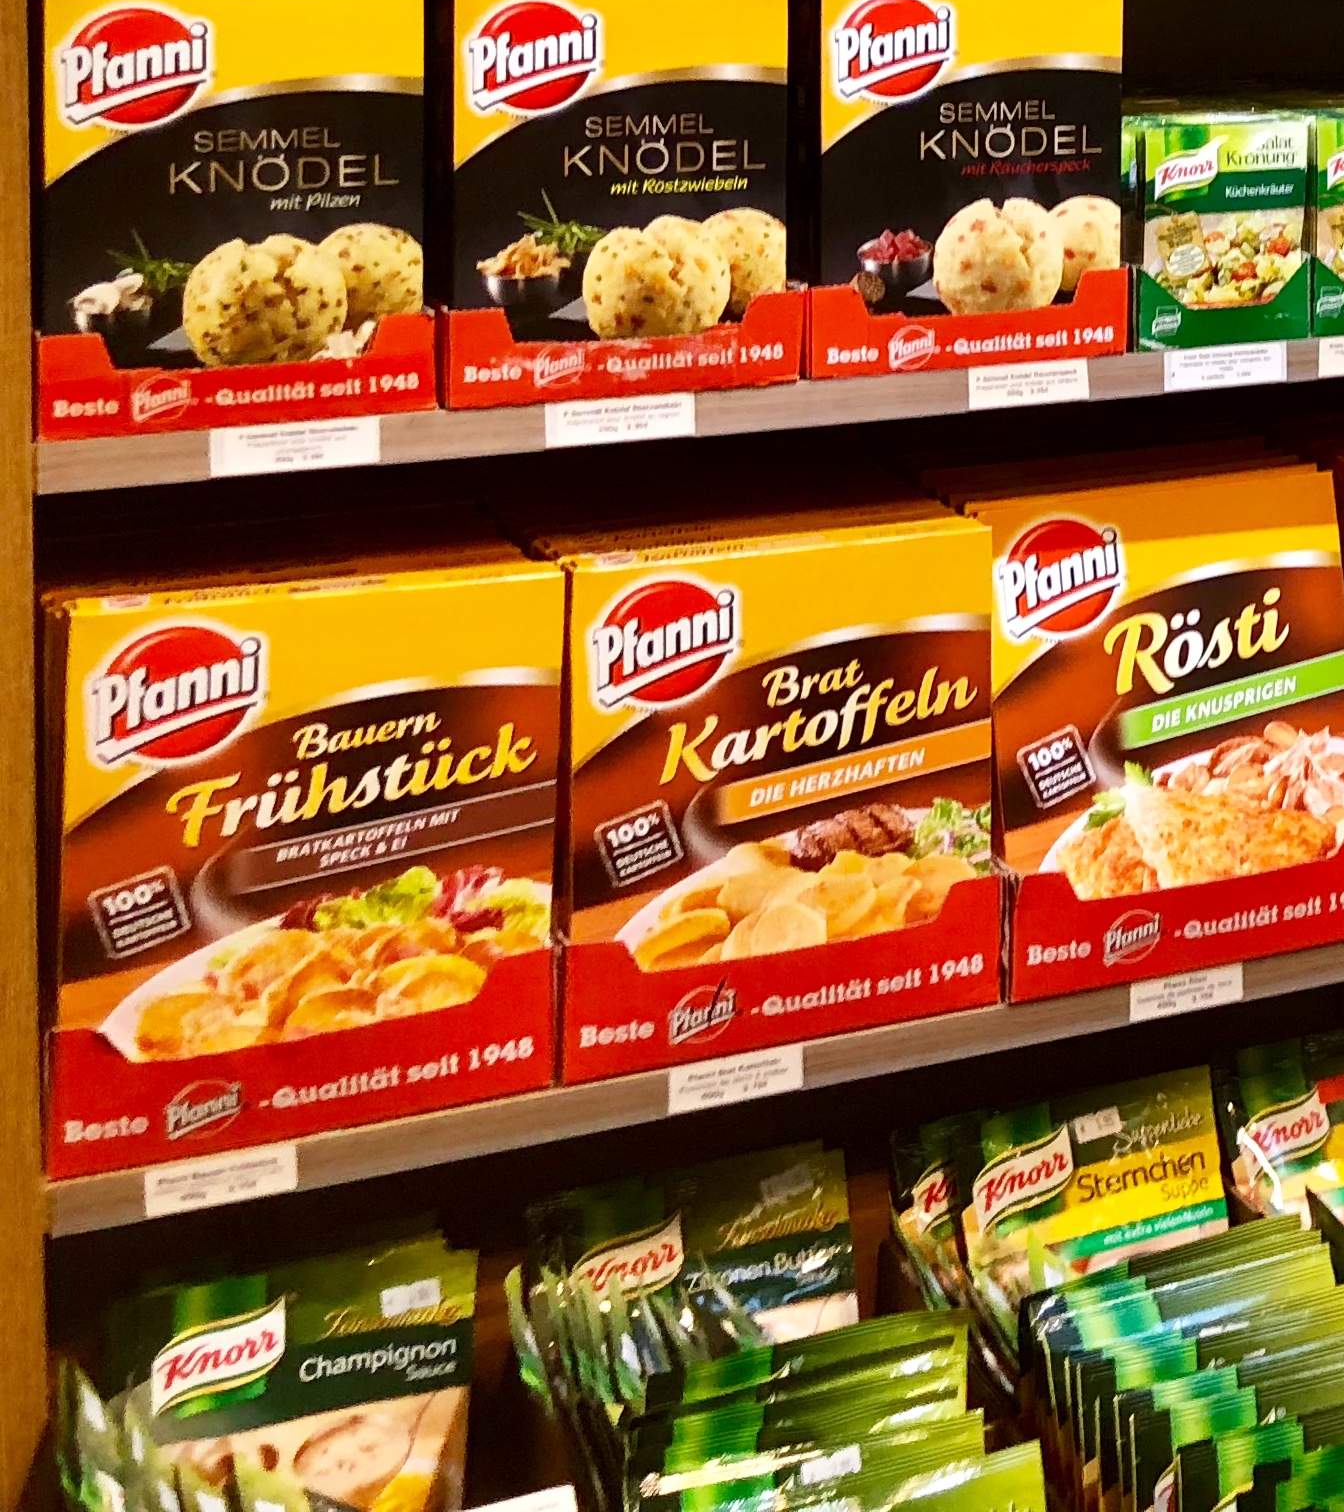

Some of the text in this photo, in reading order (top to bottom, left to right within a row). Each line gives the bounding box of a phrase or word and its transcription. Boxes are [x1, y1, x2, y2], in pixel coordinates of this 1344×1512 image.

[60, 21, 209, 106] Pfanni
[469, 12, 599, 85] Pfanni
[834, 5, 953, 77] Pfanni
[193, 126, 341, 154] SEMMEL
[585, 112, 715, 139] SEMMEL
[168, 152, 400, 196] KNÖDEL
[563, 137, 767, 178] KNÖDEL
[609, 179, 639, 195] mit
[270, 191, 362, 211] mit Pilzen
[999, 526, 1121, 615] Pfanni
[595, 589, 737, 692] Pfanni
[1104, 587, 1290, 696] Rösti
[92, 638, 262, 743] Pfanni
[761, 657, 864, 710] Brat
[1150, 674, 1298, 734] DIE KNUSPRIGEN
[292, 711, 442, 761] Bauern
[659, 666, 978, 786] Kartoffeln
[1026, 734, 1075, 772] 100%
[166, 722, 537, 849] Frühstück
[749, 748, 925, 808] DIE HERZHAFTEN
[980, 1148, 1072, 1213] Knorr
[1075, 1148, 1207, 1205] Sternchen
[156, 1328, 278, 1391] Knorr
[299, 1335, 458, 1384] Champignon
